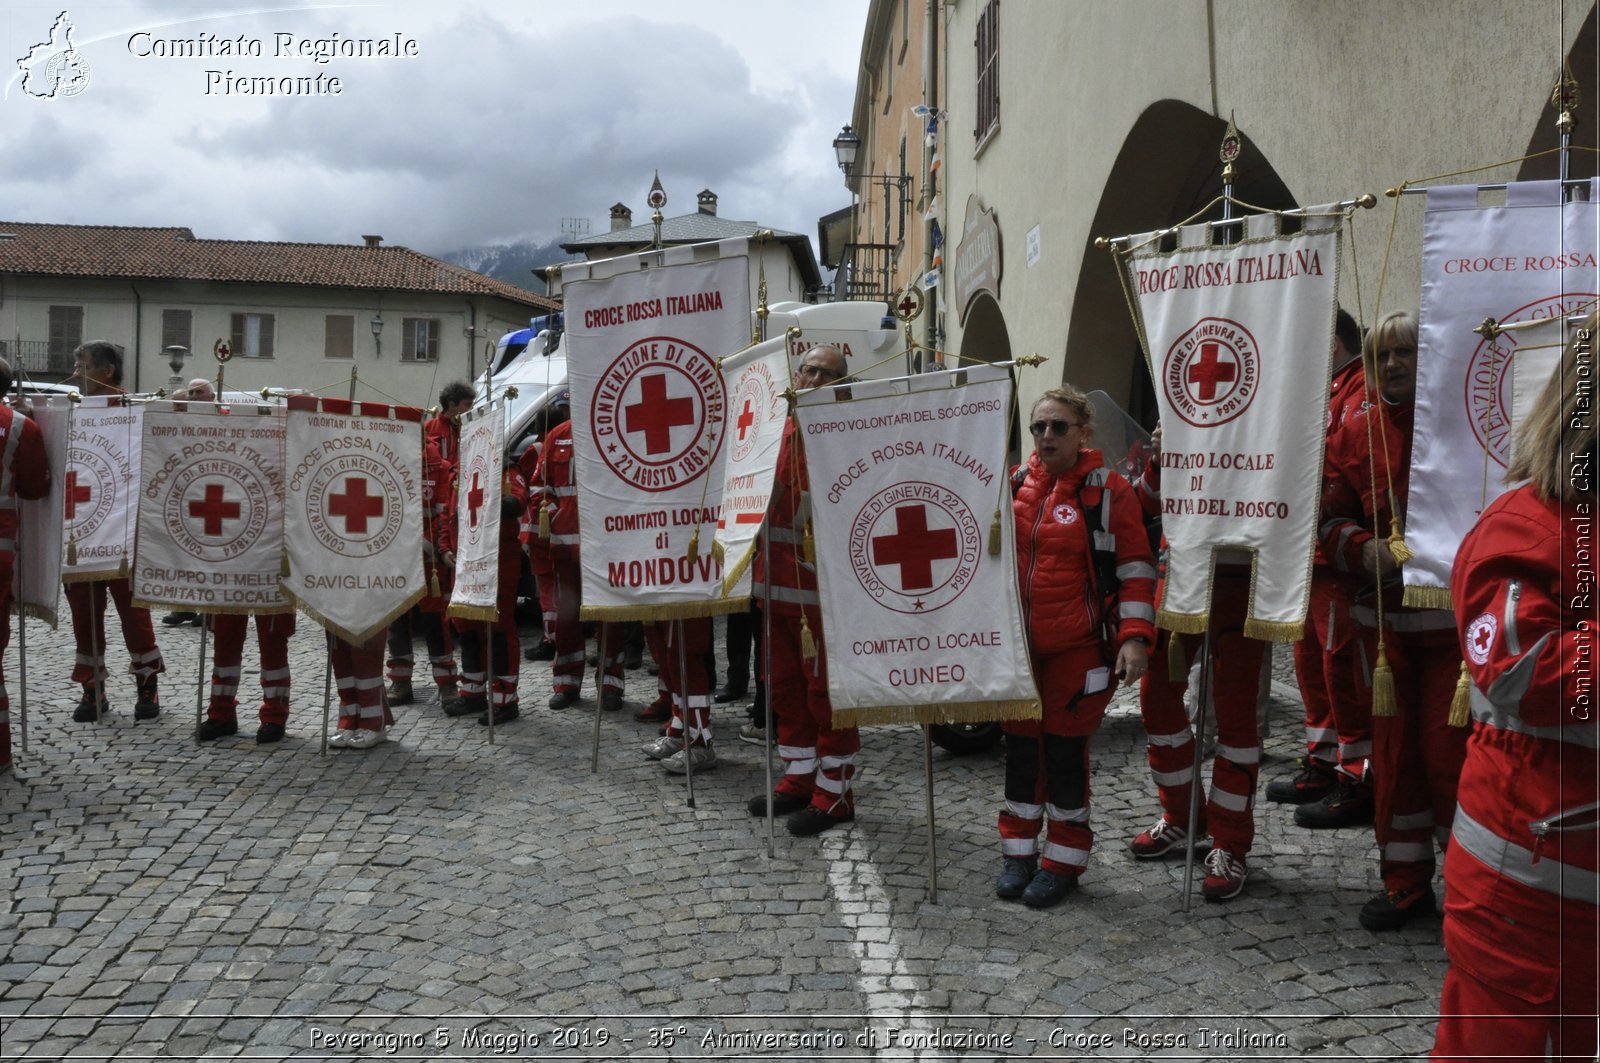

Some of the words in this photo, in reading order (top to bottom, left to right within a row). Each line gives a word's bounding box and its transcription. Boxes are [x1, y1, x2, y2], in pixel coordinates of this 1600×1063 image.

[1137, 265, 1179, 296] ROCE
[1182, 260, 1233, 290] ROSSA
[1235, 248, 1324, 284] ITALIANA
[1444, 256, 1518, 274] CROCE
[1524, 252, 1598, 271] ROSSA
[584, 305, 624, 329] CROCE
[626, 298, 663, 322] ROSSA
[666, 290, 723, 316] ITALIANA
[1195, 324, 1236, 341] GINEVRA
[665, 343, 684, 364] DI
[1184, 337, 1196, 351] DI
[1234, 336, 1248, 352] 22
[1170, 348, 1197, 418] CONVENZIONE
[1239, 351, 1255, 397] AGOSTO
[597, 343, 659, 436] CONVENZIONE
[685, 355, 723, 424] GINEVRA
[807, 421, 846, 435] CORPO
[847, 412, 912, 431] VOLONTARI
[914, 410, 936, 423] DEL
[937, 399, 1002, 420] SOCCORSO
[1216, 396, 1242, 417] 1864
[151, 426, 178, 437] CORPO
[181, 427, 227, 438] VOLONTARI
[231, 428, 247, 439] DEL
[250, 429, 287, 440] SOCCORS
[308, 416, 347, 429] VOLONTARI
[351, 420, 366, 431] DEL
[369, 421, 404, 434] SOCCORSO
[146, 453, 182, 499] CROCE
[182, 440, 237, 460] ROSSA
[289, 447, 323, 493] CROCE
[322, 436, 372, 454] ROSSA
[375, 442, 417, 502] ITALIANA
[614, 454, 634, 475] 22
[679, 445, 709, 476] 1864
[1208, 452, 1275, 471] LOCALE
[632, 464, 677, 487] AGOSTO
[827, 458, 870, 505] CROCE
[871, 440, 925, 465] ROSSA
[932, 442, 995, 487] ITALIANA
[1190, 475, 1204, 492] DI
[884, 485, 940, 504] GINEVRA
[941, 494, 959, 511] 22
[870, 501, 885, 514] DI
[1197, 498, 1231, 517] DEL
[1234, 501, 1289, 520] BOSCO
[604, 510, 667, 532] COMITATO
[655, 532, 669, 550] di
[955, 508, 978, 563] AGOSTO
[77, 544, 123, 559] ARAGLIO
[852, 510, 885, 598] CONVENZIONE
[142, 567, 207, 585] GRUPPO
[213, 572, 228, 585] DI
[303, 574, 408, 590] SAVIGLIANO
[950, 566, 971, 592] 1864
[142, 582, 215, 602] COMITATO
[852, 636, 930, 656] COMITATO
[937, 631, 1002, 649] LOCALE
[888, 664, 965, 687] CUNEO
